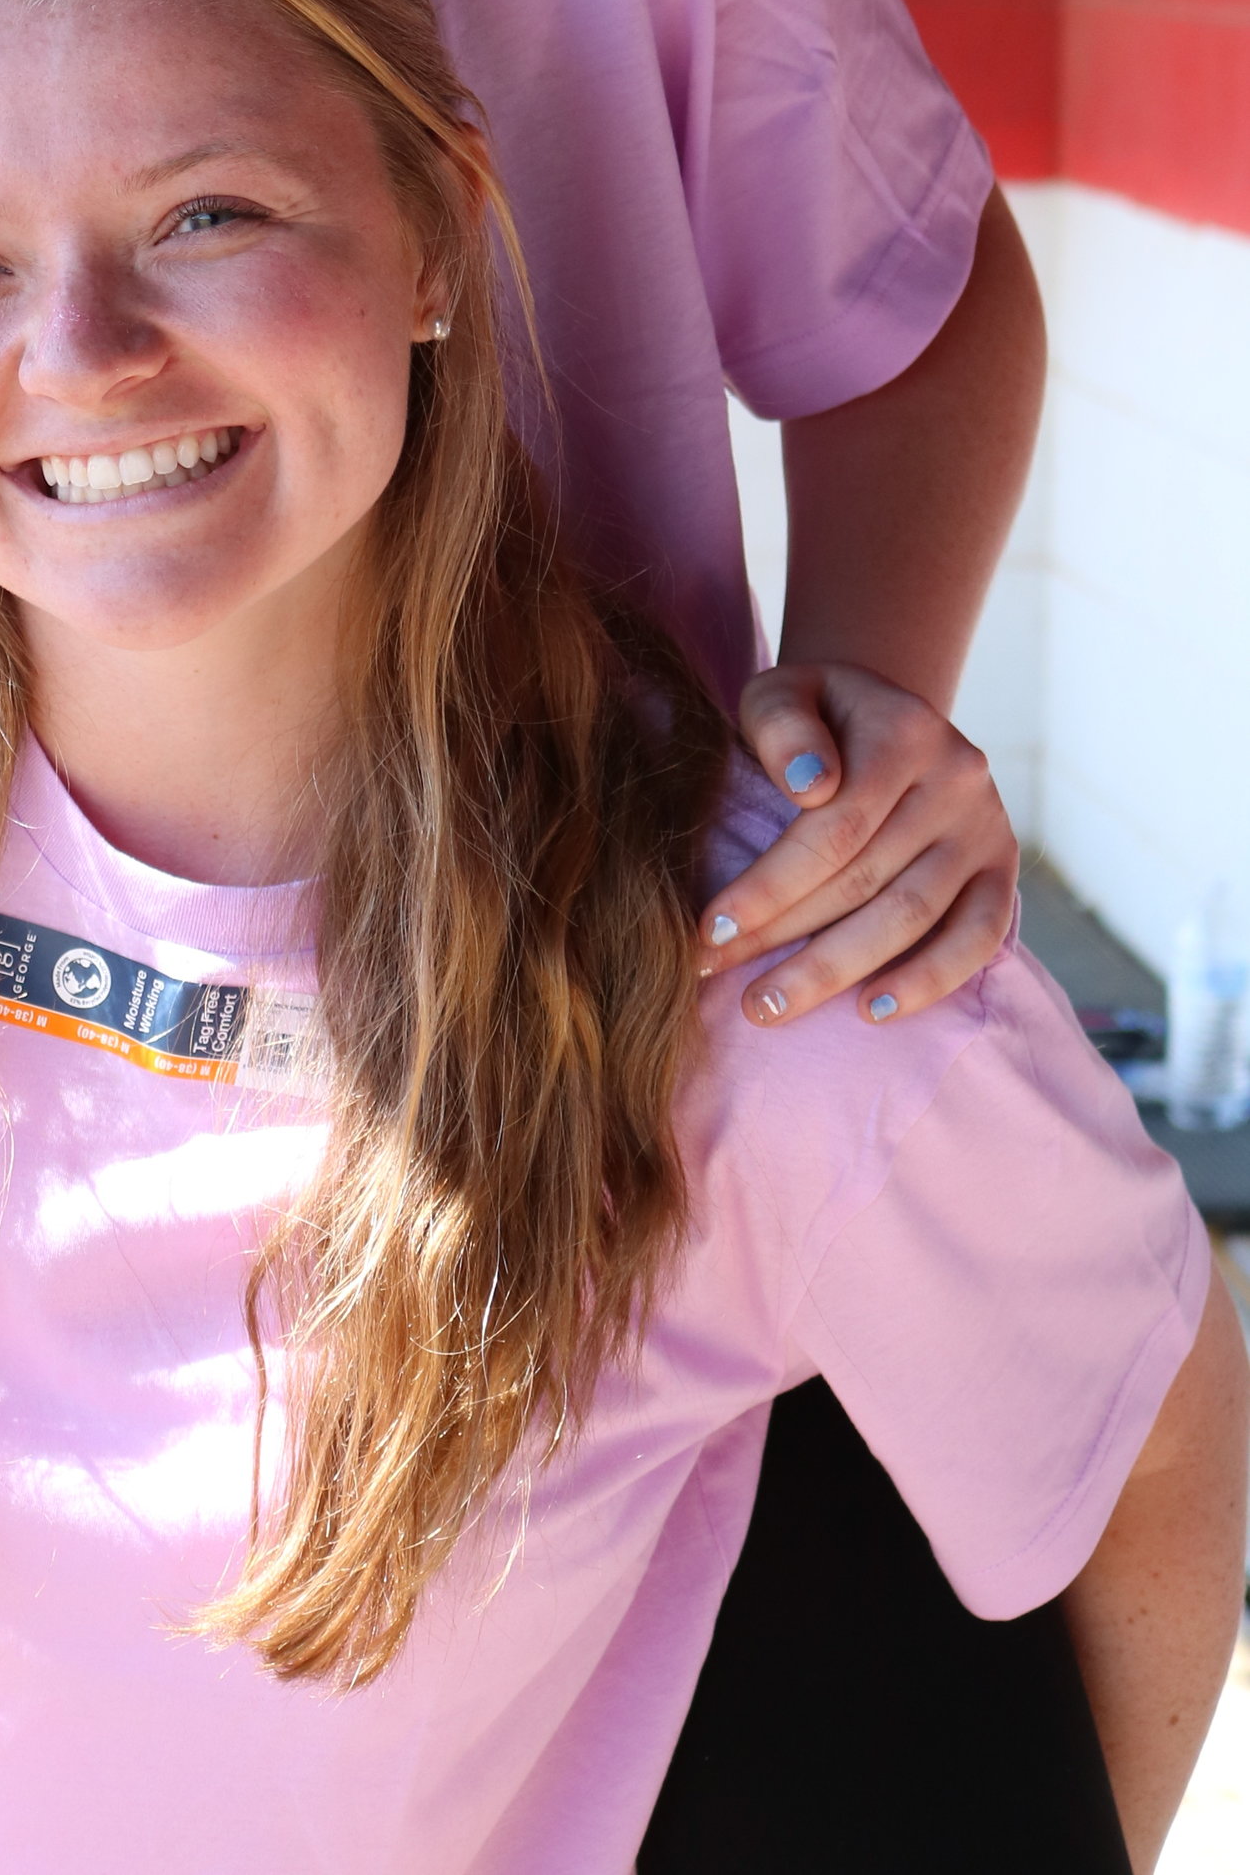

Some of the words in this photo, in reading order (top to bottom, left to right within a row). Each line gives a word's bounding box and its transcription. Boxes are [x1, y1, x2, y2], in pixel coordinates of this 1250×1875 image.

[13, 933, 37, 994] GEORGE
[123, 969, 147, 1031] Moisture
[138, 979, 165, 1034] Wicking
[200, 990, 221, 1024] Free
[36, 1016, 47, 1027] M
[211, 993, 237, 1053] Comfort
[77, 1025, 118, 1049] (38-40)
[120, 1042, 130, 1053] M
[193, 1025, 215, 1054] Tag
[154, 1057, 198, 1076] (38-40)
[200, 1065, 210, 1076] M
